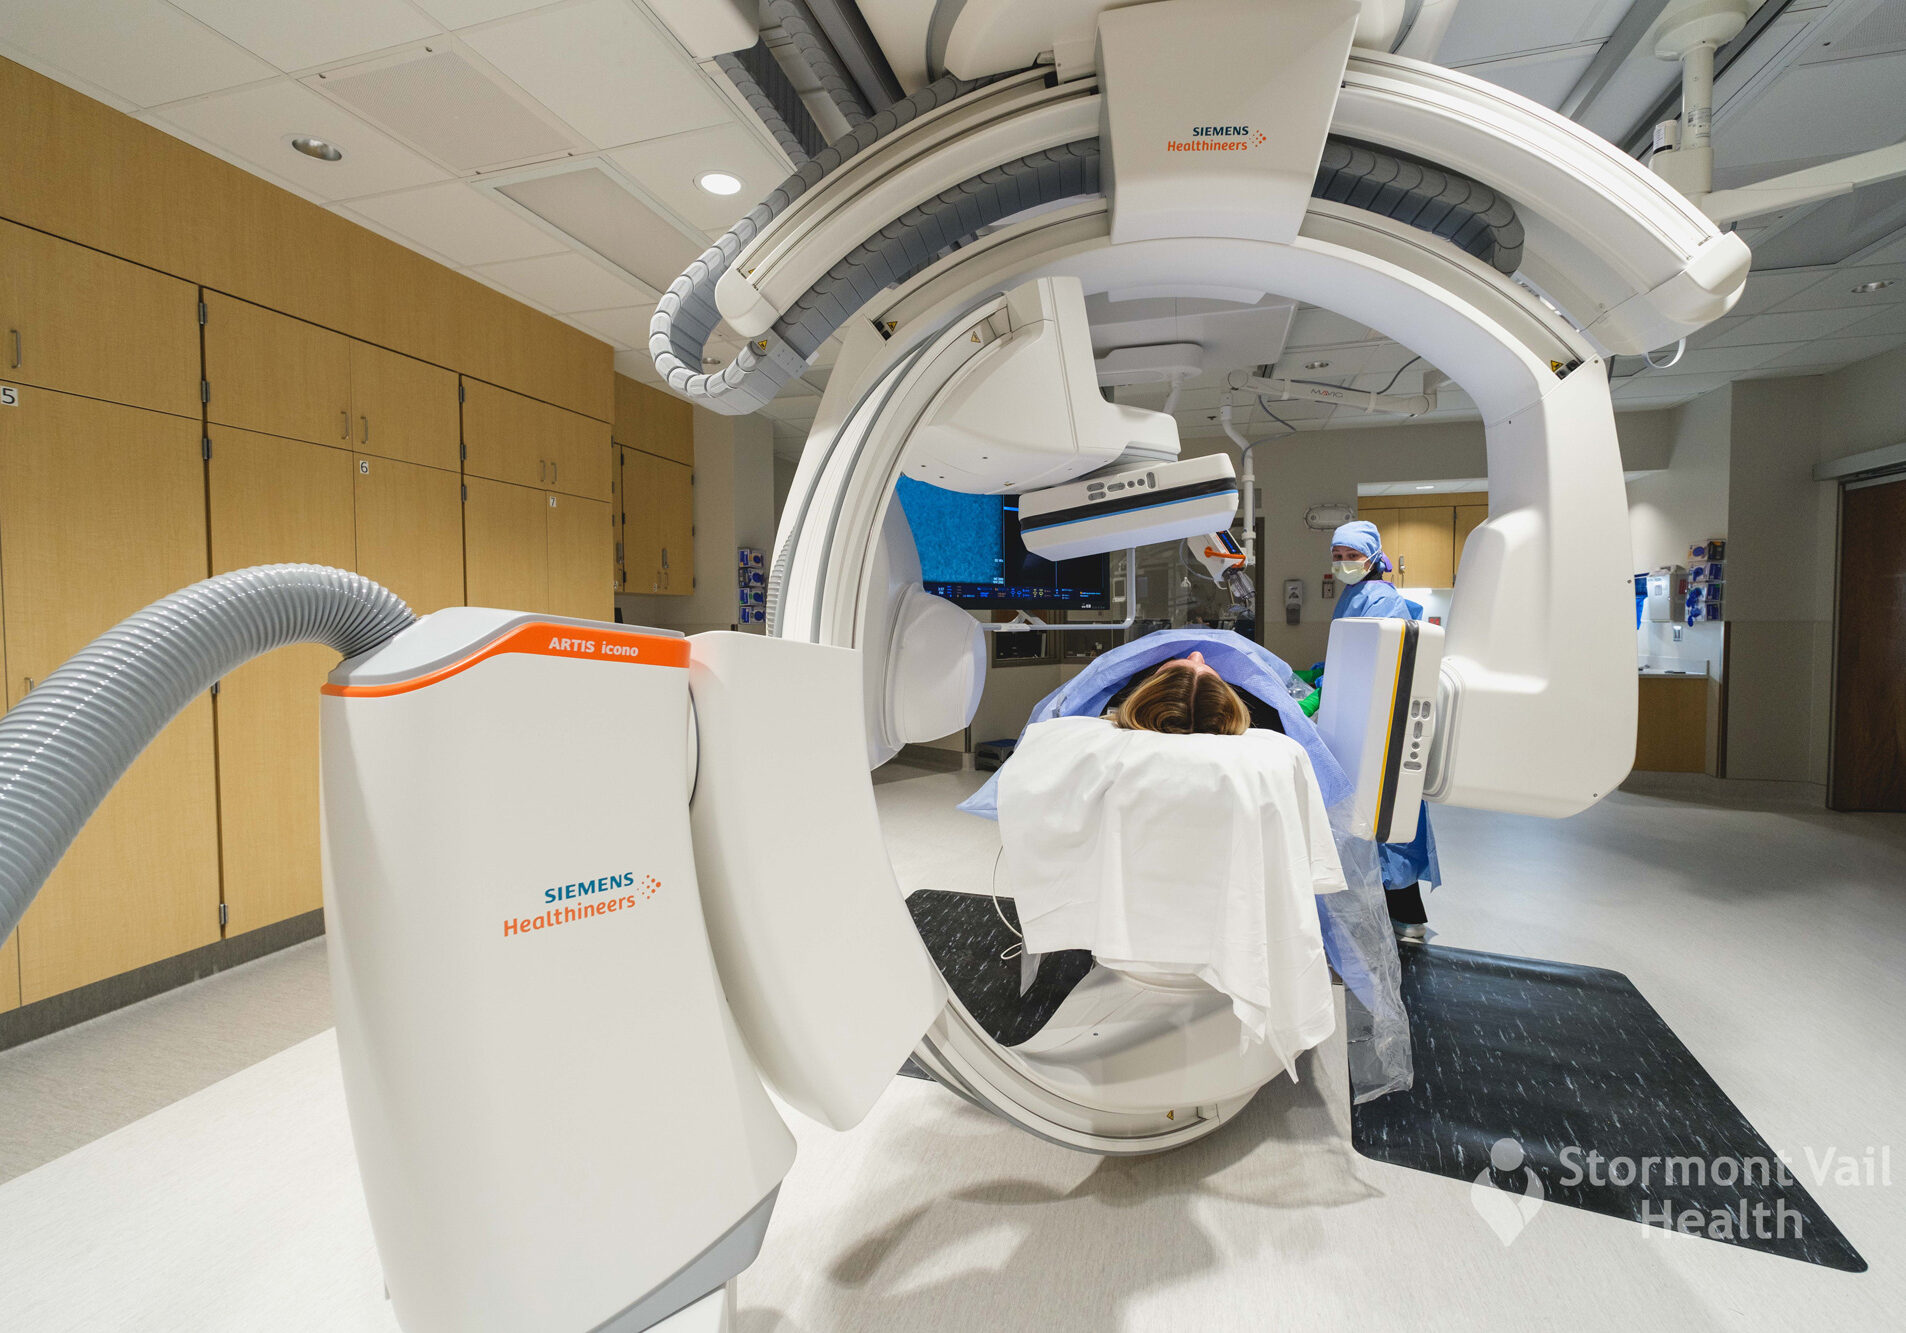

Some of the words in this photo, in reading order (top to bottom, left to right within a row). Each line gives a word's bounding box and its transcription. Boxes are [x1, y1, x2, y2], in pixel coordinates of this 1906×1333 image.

[1192, 126, 1249, 137] SIEMENS
[1167, 139, 1248, 152] Healthineers
[2, 387, 15, 404] 5
[360, 461, 369, 473] 6
[548, 636, 596, 654] ARTIS
[601, 640, 639, 657] icono
[544, 871, 634, 904] SIEMENS
[503, 894, 636, 938] Healthineers
